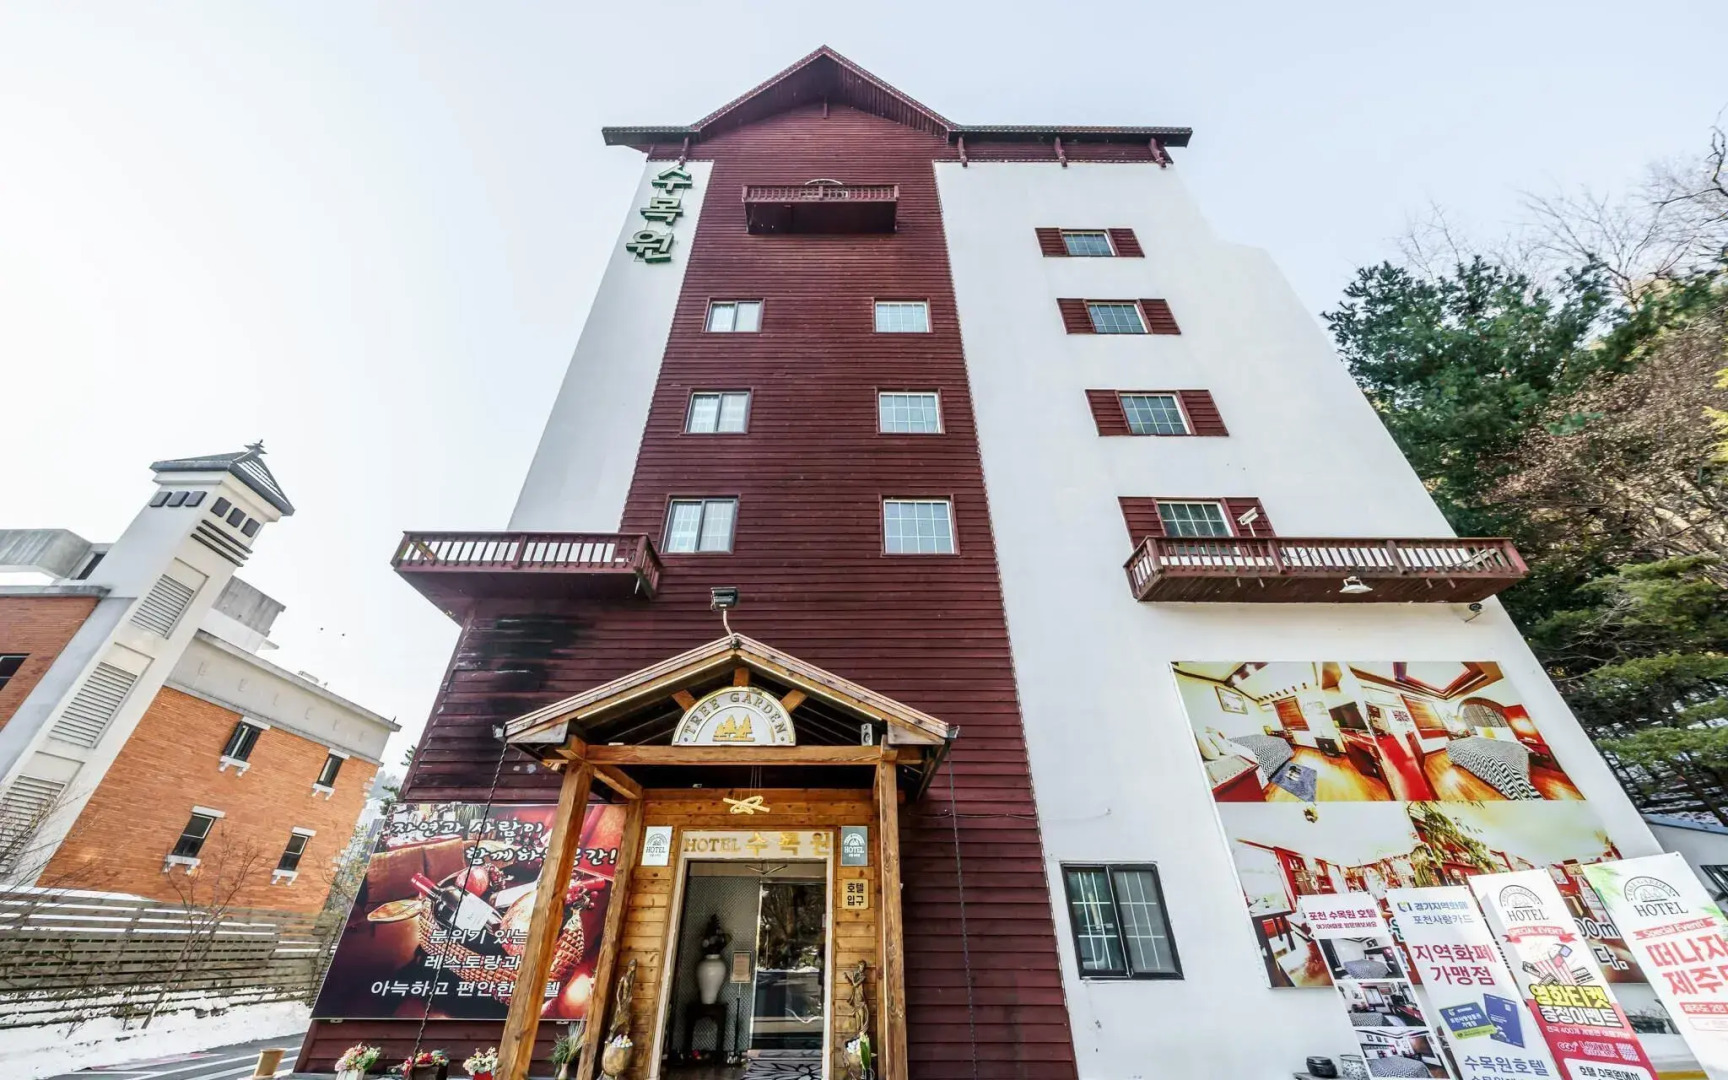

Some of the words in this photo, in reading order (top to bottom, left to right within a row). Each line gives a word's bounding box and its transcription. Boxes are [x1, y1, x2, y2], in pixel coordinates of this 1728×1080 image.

[626, 165, 693, 263] 수목원
[685, 698, 720, 735] TREE
[729, 692, 788, 735] GARDEN
[392, 820, 464, 838] 자연과
[470, 820, 543, 846] 사람이
[683, 837, 741, 853] HOTEL
[746, 831, 831, 857] 수목원
[844, 846, 865, 854] HOTEL
[465, 847, 548, 866] 함께하
[847, 883, 864, 894] 호텔
[847, 895, 864, 906] 입구
[1414, 901, 1468, 911] 경기지역화폐
[1633, 902, 1689, 917] HOTEL
[1308, 911, 1327, 920] 포천
[1329, 909, 1356, 920] 수목원
[1357, 908, 1377, 918] 호텔
[1413, 914, 1474, 925] 포천사랑카드
[1507, 909, 1549, 921] HOTEL
[429, 929, 487, 944] 분위기
[493, 929, 528, 945] 있는
[424, 954, 521, 970] 레스토랑과
[1412, 944, 1497, 963] 지역화폐
[1430, 965, 1496, 985] 가맹점
[1662, 965, 1728, 995] 제주
[371, 980, 449, 997] 아늑하고
[456, 981, 515, 998] 편안한
[1529, 983, 1613, 1009] 영화티켓
[1538, 1005, 1624, 1028] 증정이벤트
[1464, 1056, 1549, 1077] 수목원호텔
